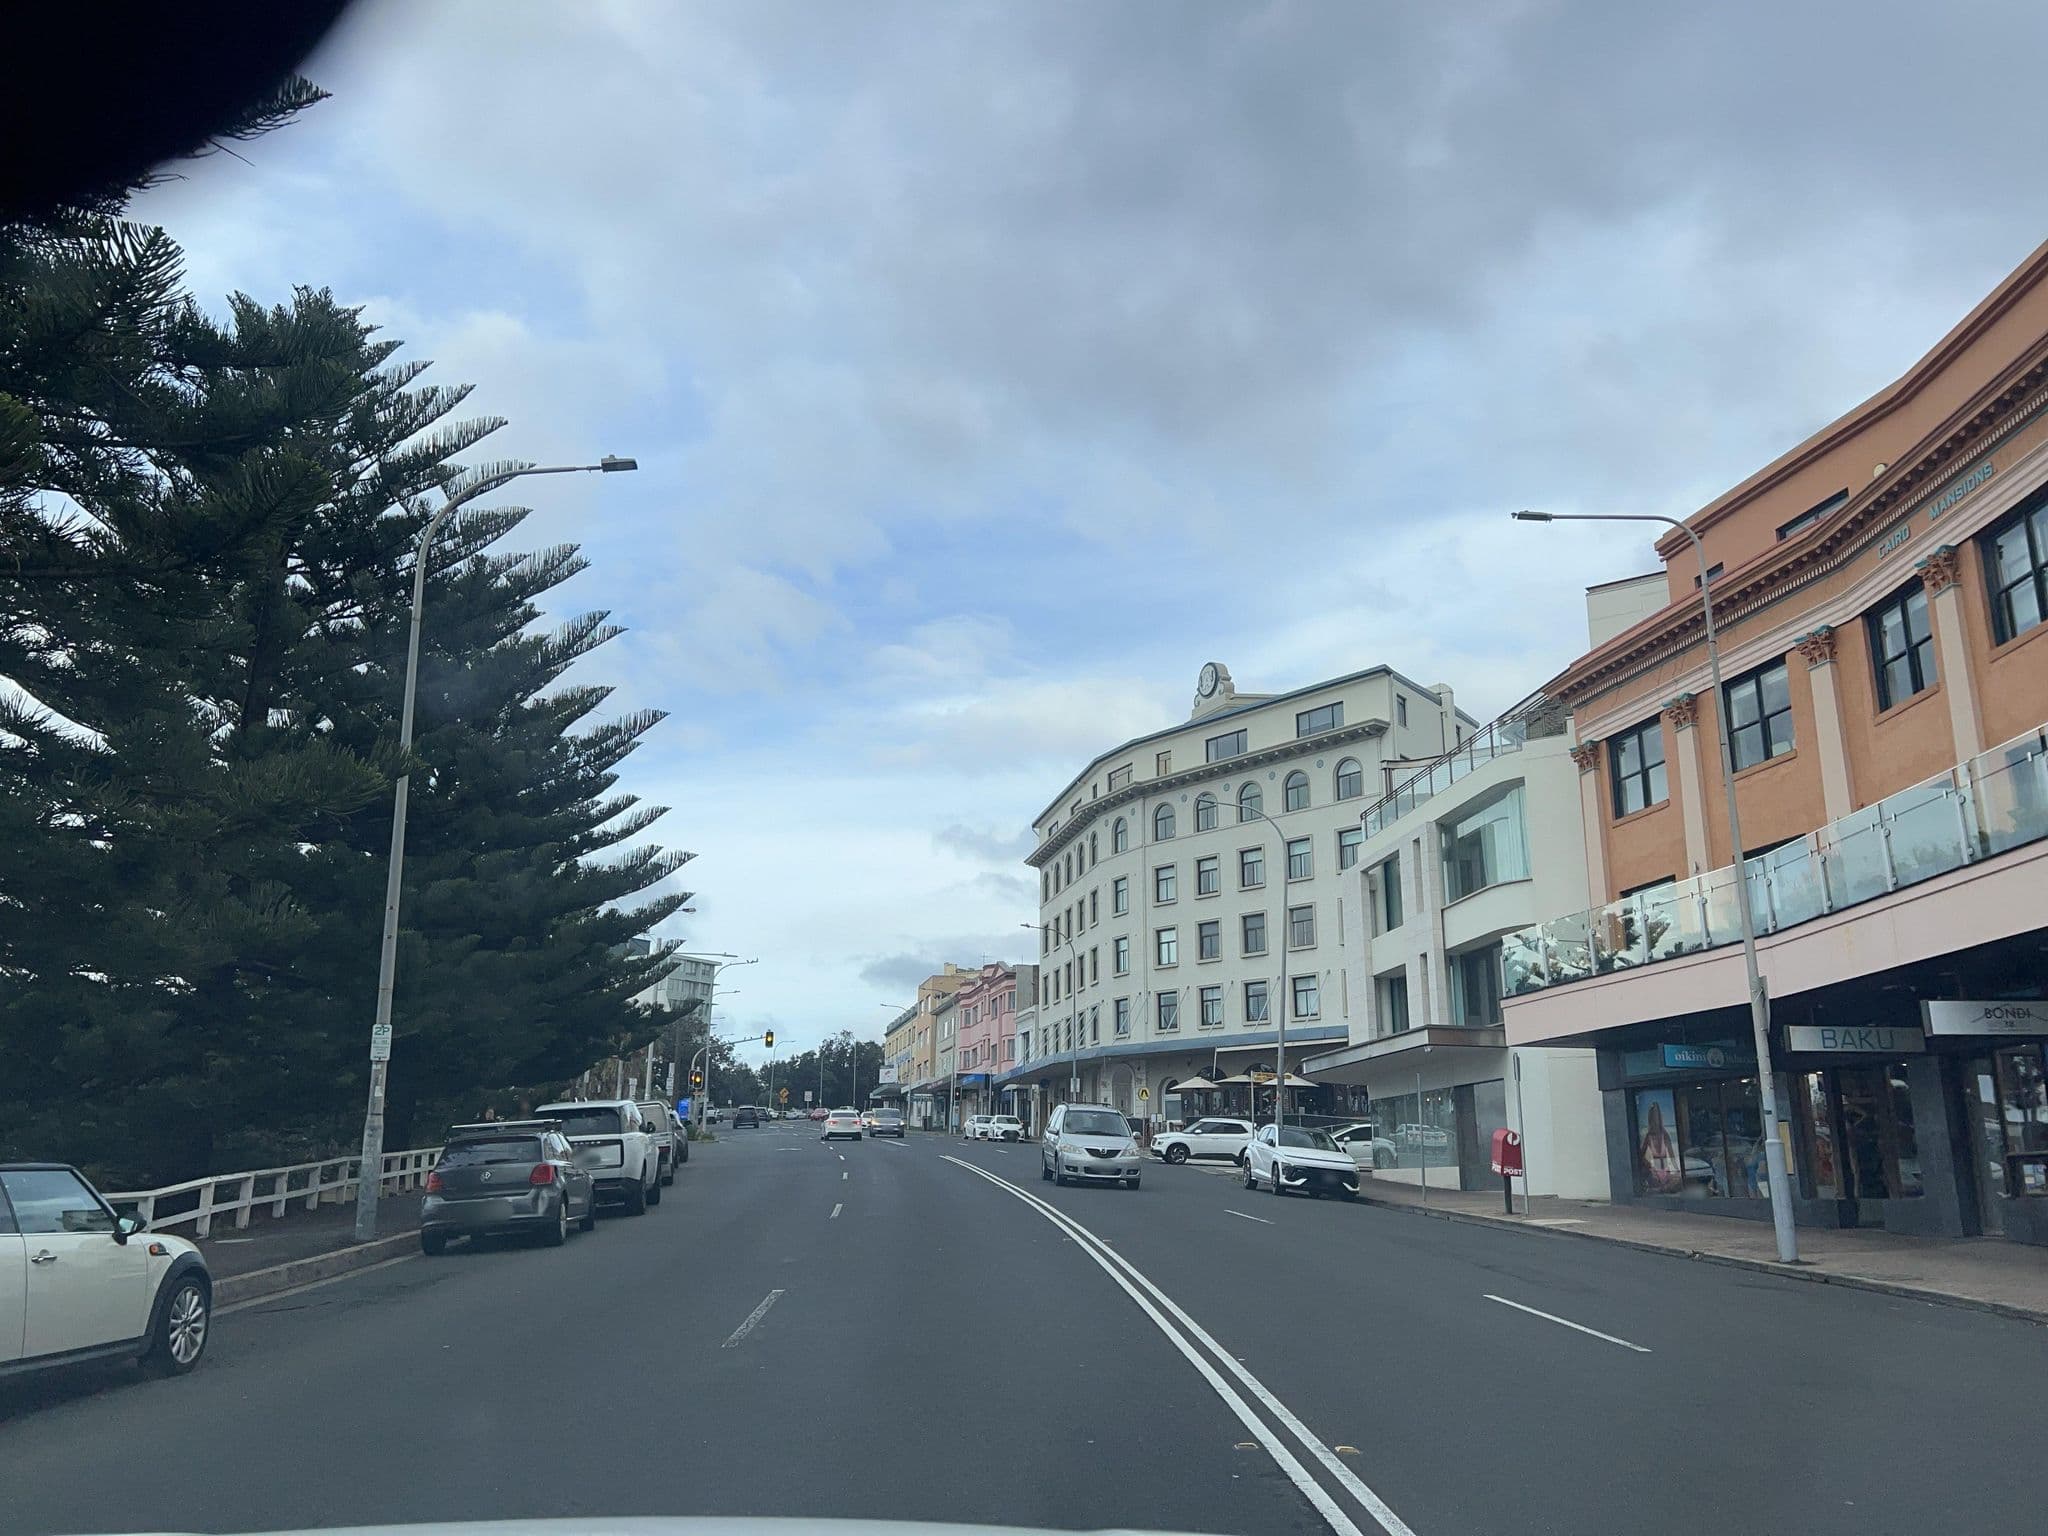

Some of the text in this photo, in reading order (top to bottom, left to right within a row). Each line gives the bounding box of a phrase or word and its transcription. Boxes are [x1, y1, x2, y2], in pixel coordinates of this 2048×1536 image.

[1984, 1007, 2031, 1019] BONDI
[374, 1026, 390, 1035] 2P
[1821, 1029, 1895, 1050] BAKU
[1503, 1167, 1522, 1175] POST
